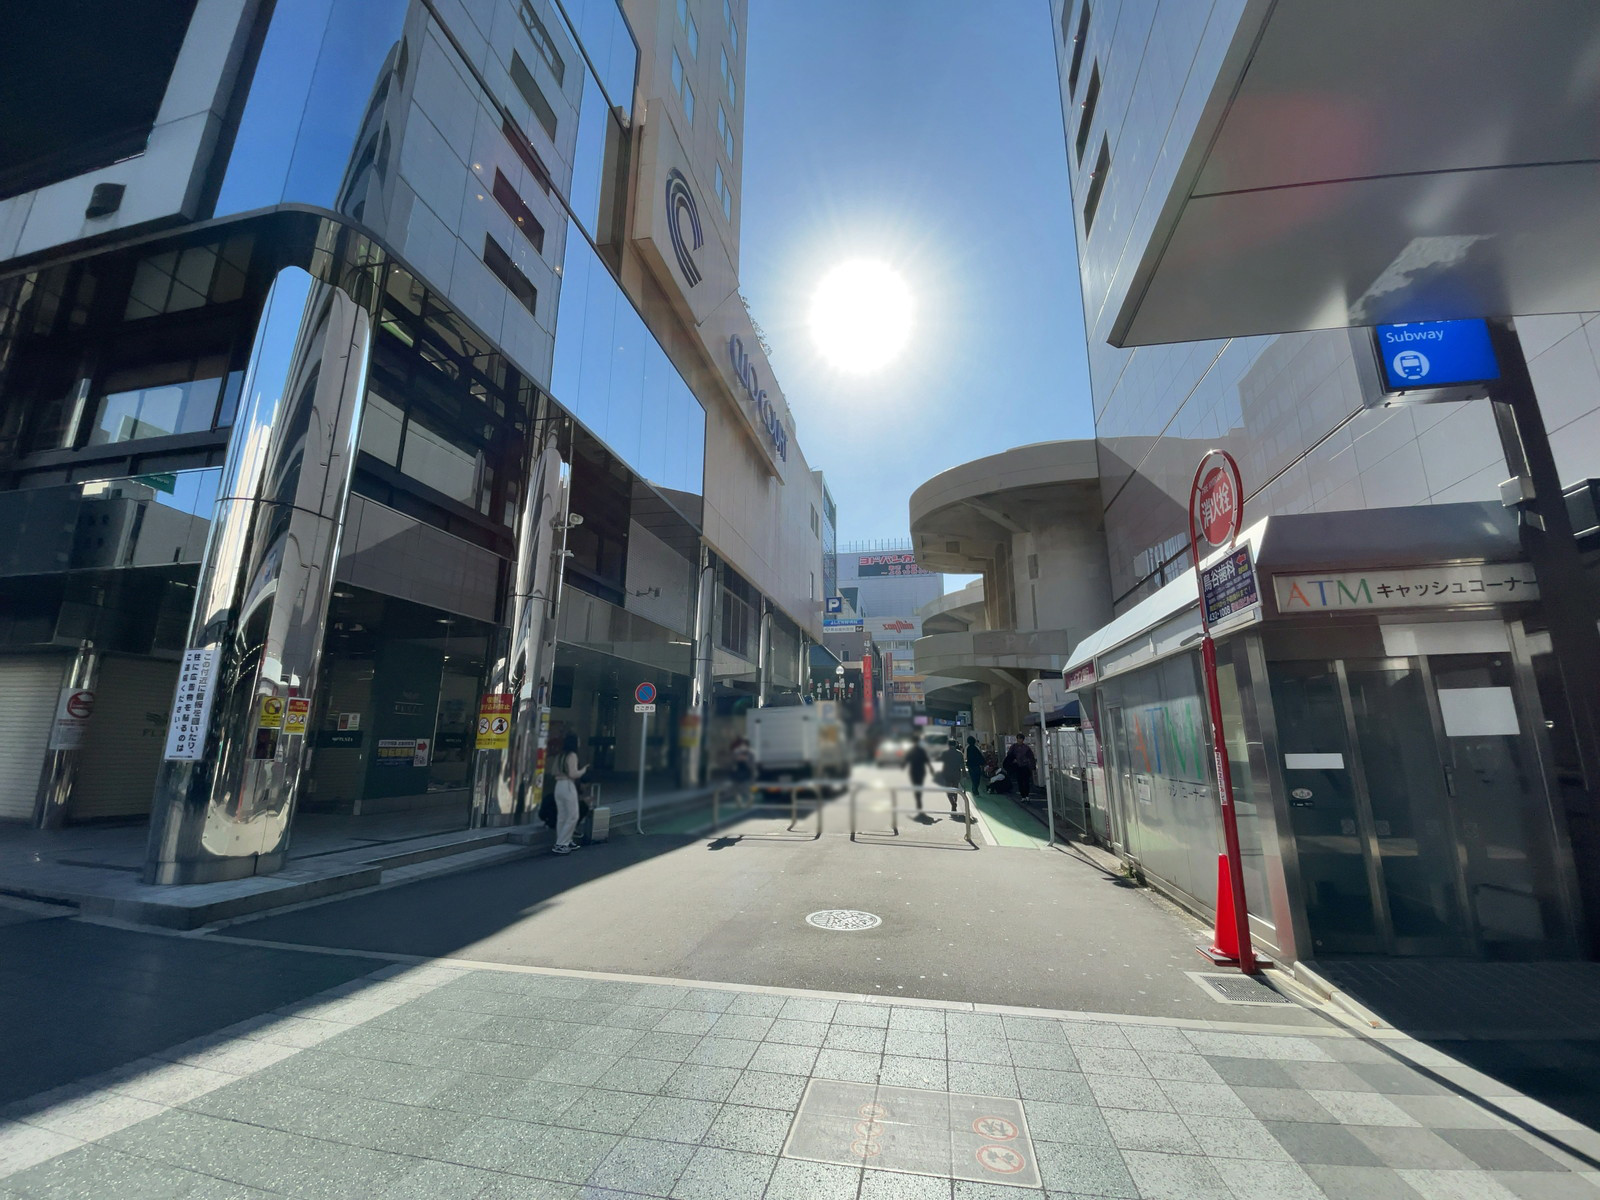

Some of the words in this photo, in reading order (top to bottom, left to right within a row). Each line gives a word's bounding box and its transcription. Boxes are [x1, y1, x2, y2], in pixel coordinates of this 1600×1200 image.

[1386, 329, 1444, 343] Subway
[1202, 484, 1232, 529] 消火栓
[859, 554, 916, 566] ヨドバシカ
[1286, 578, 1373, 607] ATM
[1377, 576, 1537, 598] キャッシュコーナー
[828, 598, 840, 612] P
